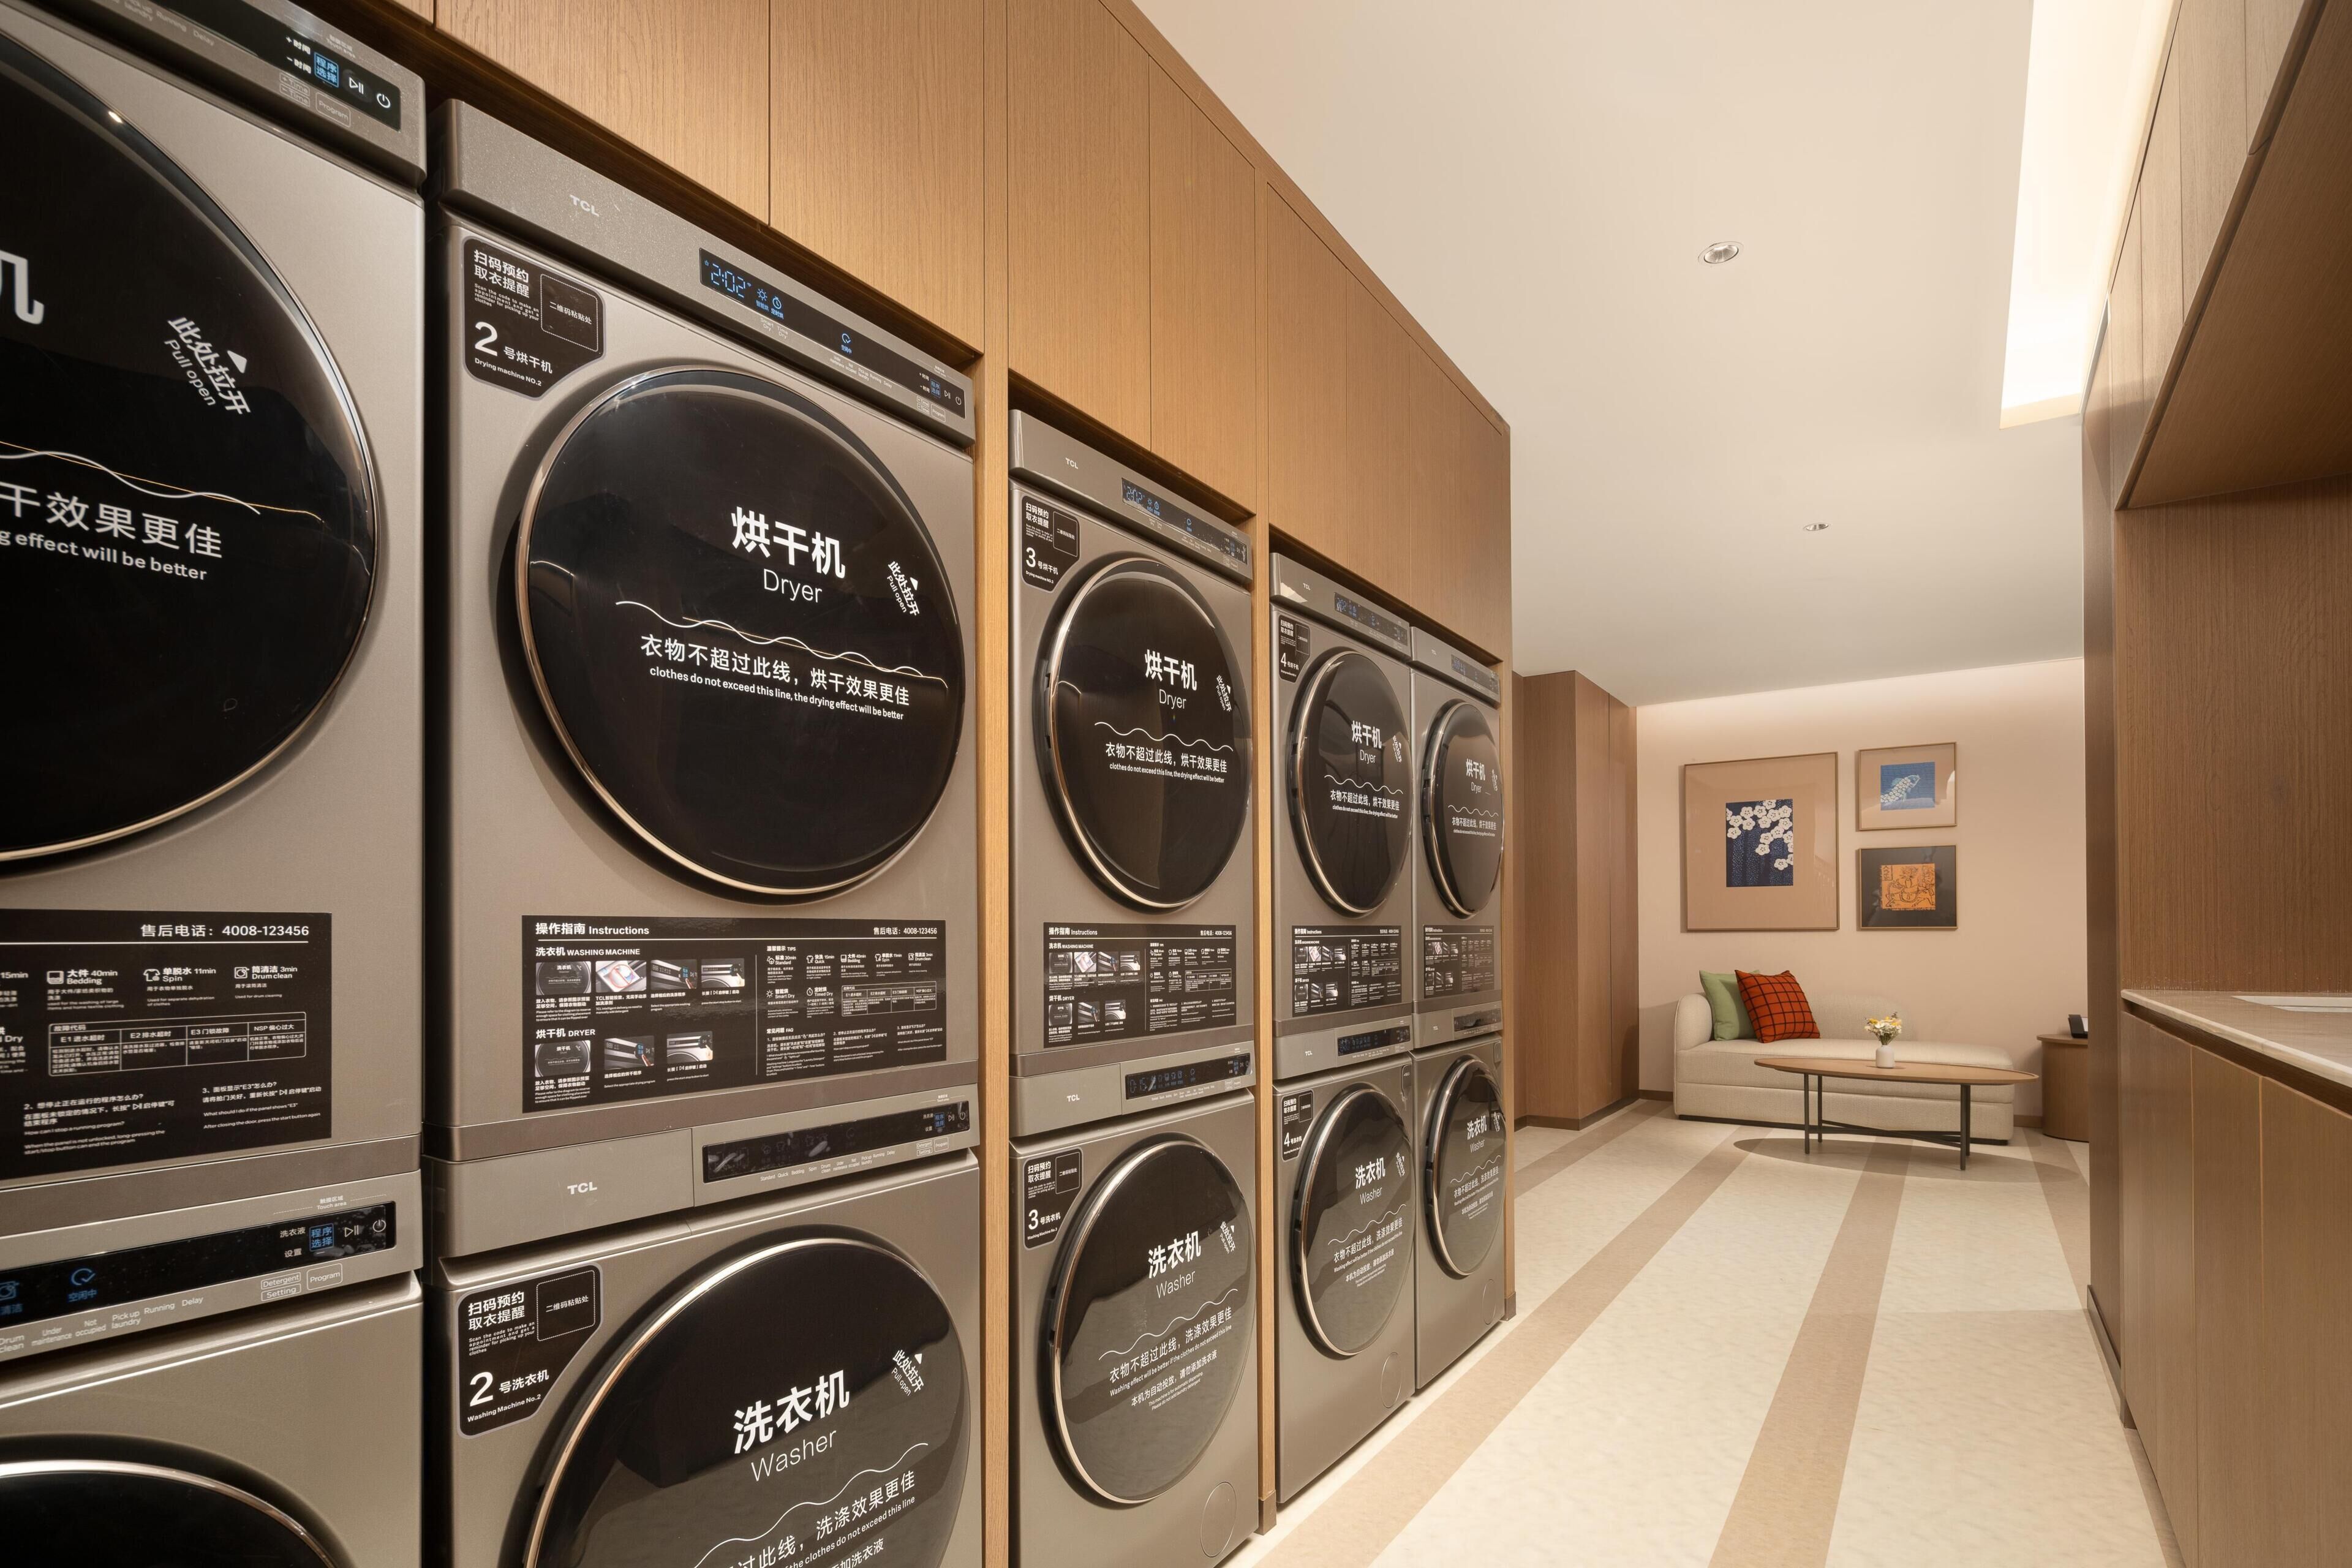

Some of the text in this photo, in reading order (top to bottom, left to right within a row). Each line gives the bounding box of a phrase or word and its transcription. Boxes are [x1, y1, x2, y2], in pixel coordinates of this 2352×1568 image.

[319, 101, 349, 120] Program
[570, 195, 600, 217] TCL
[474, 250, 529, 283] 扫码预约
[475, 265, 529, 298] 取衣提醒
[550, 302, 592, 324] 二维码粘贴处
[475, 322, 552, 374] 2 号烘干机
[164, 339, 216, 406] Pull open
[167, 317, 251, 415] 此处拉开
[475, 358, 541, 386] Drying machine NO.2
[1066, 458, 1079, 469] TCL
[1026, 502, 1049, 519] 扫码预约
[1026, 512, 1049, 529] 取衣提醒
[731, 507, 846, 579] 烘干机
[15, 533, 80, 556] effect
[83, 546, 118, 564] will
[123, 552, 146, 568] be
[150, 557, 207, 581] better
[1026, 547, 1058, 575] 3 号烘干机
[763, 569, 823, 603] Dryer
[887, 575, 907, 612] Pull open
[888, 561, 919, 616] 此处拉开
[1145, 649, 1197, 691] 烘干机
[1281, 653, 1287, 667] 4
[650, 666, 903, 720] clothes do not exceed this line, the drying effect will be better
[1159, 689, 1186, 709] Dryer
[1351, 720, 1382, 749] 烘干机
[1360, 750, 1376, 764] Dryer
[1466, 758, 1485, 781] 烘干机
[1471, 782, 1481, 793] Dryer
[222, 925, 309, 937] 4008-123456
[536, 923, 649, 935] 操作指南 Instructions
[536, 948, 565, 956] 洗衣机
[536, 1028, 565, 1039] 烘干机
[1467, 1115, 1487, 1140] 洗衣机
[1284, 1133, 1290, 1147] 4
[1470, 1139, 1485, 1153] Washer
[1028, 1161, 1051, 1174] 扫码预约
[1028, 1170, 1051, 1183] 取衣提醒
[1355, 1157, 1385, 1189] 洗衣机
[567, 1181, 597, 1195] TCL
[1360, 1187, 1382, 1205] Washer
[1028, 1210, 1060, 1229] 3 号洗衣机
[280, 1227, 306, 1237] 洗衣液
[285, 1248, 302, 1257] 设置
[1148, 1231, 1201, 1279] 洗衣机
[263, 1275, 300, 1287] Detergent
[310, 1272, 340, 1283] Program
[1156, 1271, 1196, 1298] Washer
[182, 1297, 203, 1306] Delay
[267, 1287, 296, 1298] Setting
[469, 1291, 524, 1316] 扫码预约
[546, 1295, 589, 1312] 二维码粘贴处
[144, 1303, 175, 1314] Running
[469, 1305, 525, 1330] 取衣提醒
[111, 1319, 141, 1329] laundry
[892, 1349, 924, 1393] 此处拉开
[892, 1367, 911, 1396] Pull open
[470, 1370, 549, 1406] 2 号洗衣机
[467, 1394, 541, 1422] Washing Machine No.2
[733, 1370, 850, 1455] 洗衣机
[751, 1430, 837, 1482] Washer
[805, 1496, 915, 1564] clothes do not exceed this line
